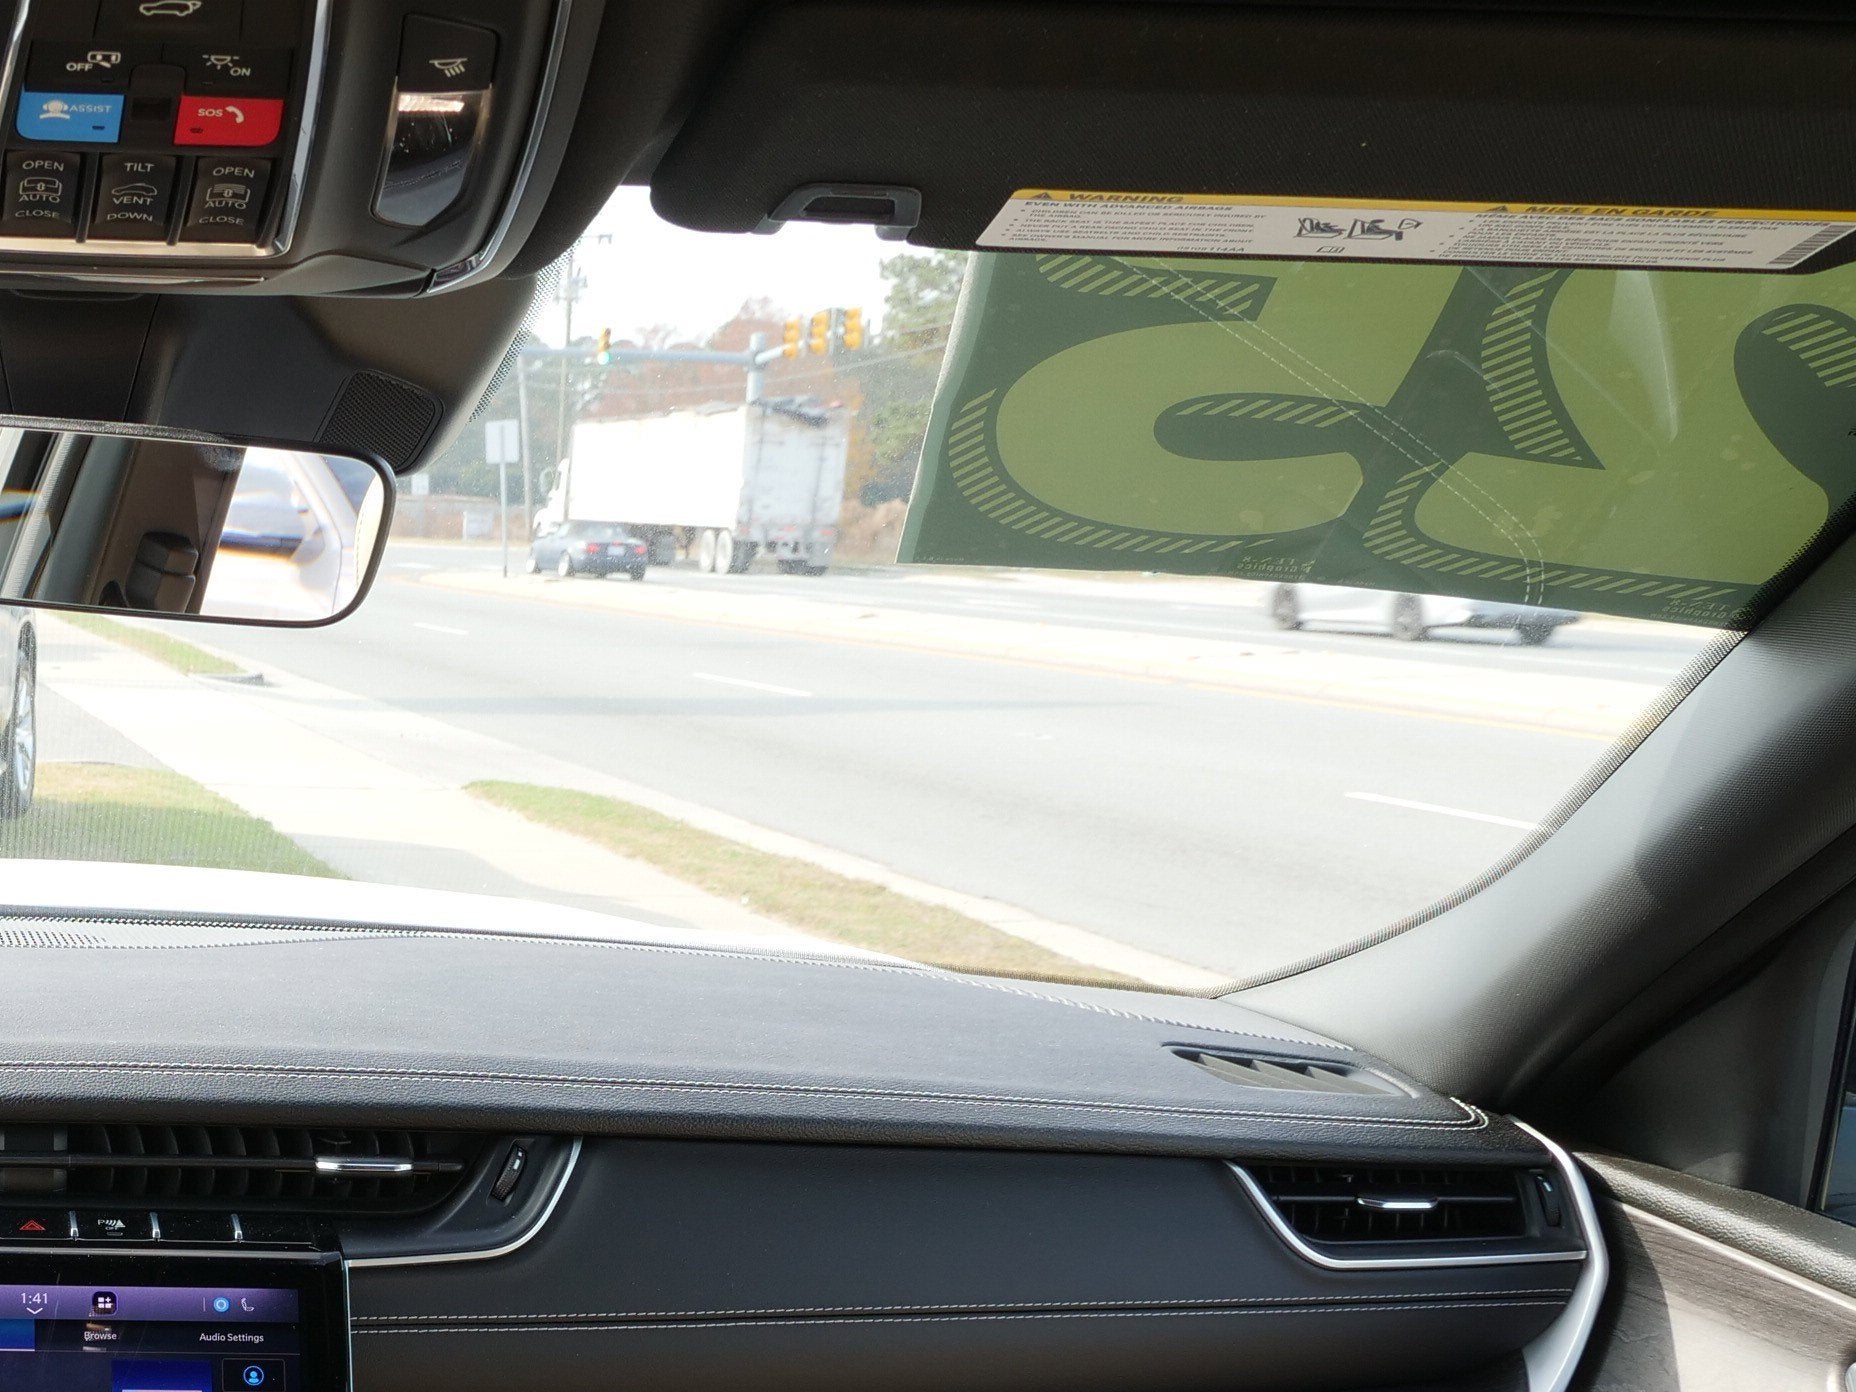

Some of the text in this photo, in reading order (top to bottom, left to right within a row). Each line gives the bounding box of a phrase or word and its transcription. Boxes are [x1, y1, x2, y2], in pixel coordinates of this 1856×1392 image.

[66, 62, 93, 72] OFF
[230, 67, 251, 77] ON
[69, 104, 112, 114] ASSIST
[198, 108, 223, 118] SOS
[22, 160, 64, 172] OPEN
[124, 162, 155, 173] TILT
[212, 167, 256, 178] OPEN
[19, 194, 61, 204] AUTO
[112, 196, 153, 206] VENT
[1069, 193, 1184, 203] WARNING
[204, 200, 247, 210] AUTO
[14, 209, 60, 219] CLOSE
[107, 211, 154, 222] DOWN
[198, 215, 245, 226] CLOSE
[21, 1292, 48, 1304] 1:41
[84, 1331, 117, 1341] Browse
[199, 1332, 264, 1344] Audio Settings
